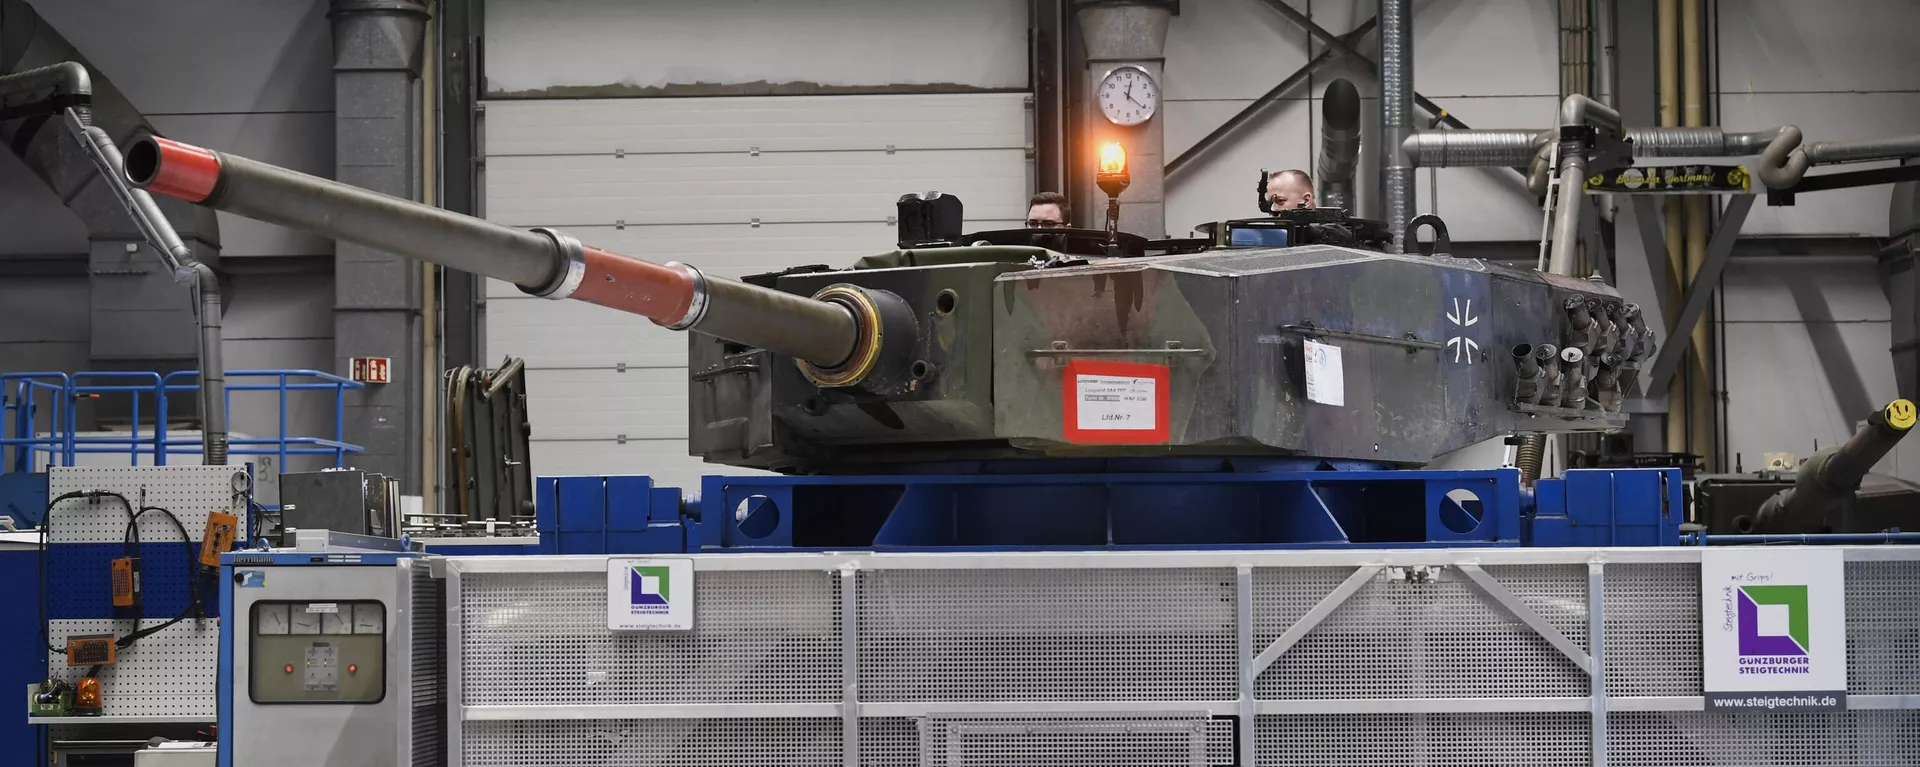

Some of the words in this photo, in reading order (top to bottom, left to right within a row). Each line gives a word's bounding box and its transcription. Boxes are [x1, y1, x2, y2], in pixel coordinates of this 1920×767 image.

[1665, 173, 1716, 183] Dortmund
[1746, 572, 1774, 582] Grips!
[1714, 696, 1836, 708] www.steigtechnik.de
